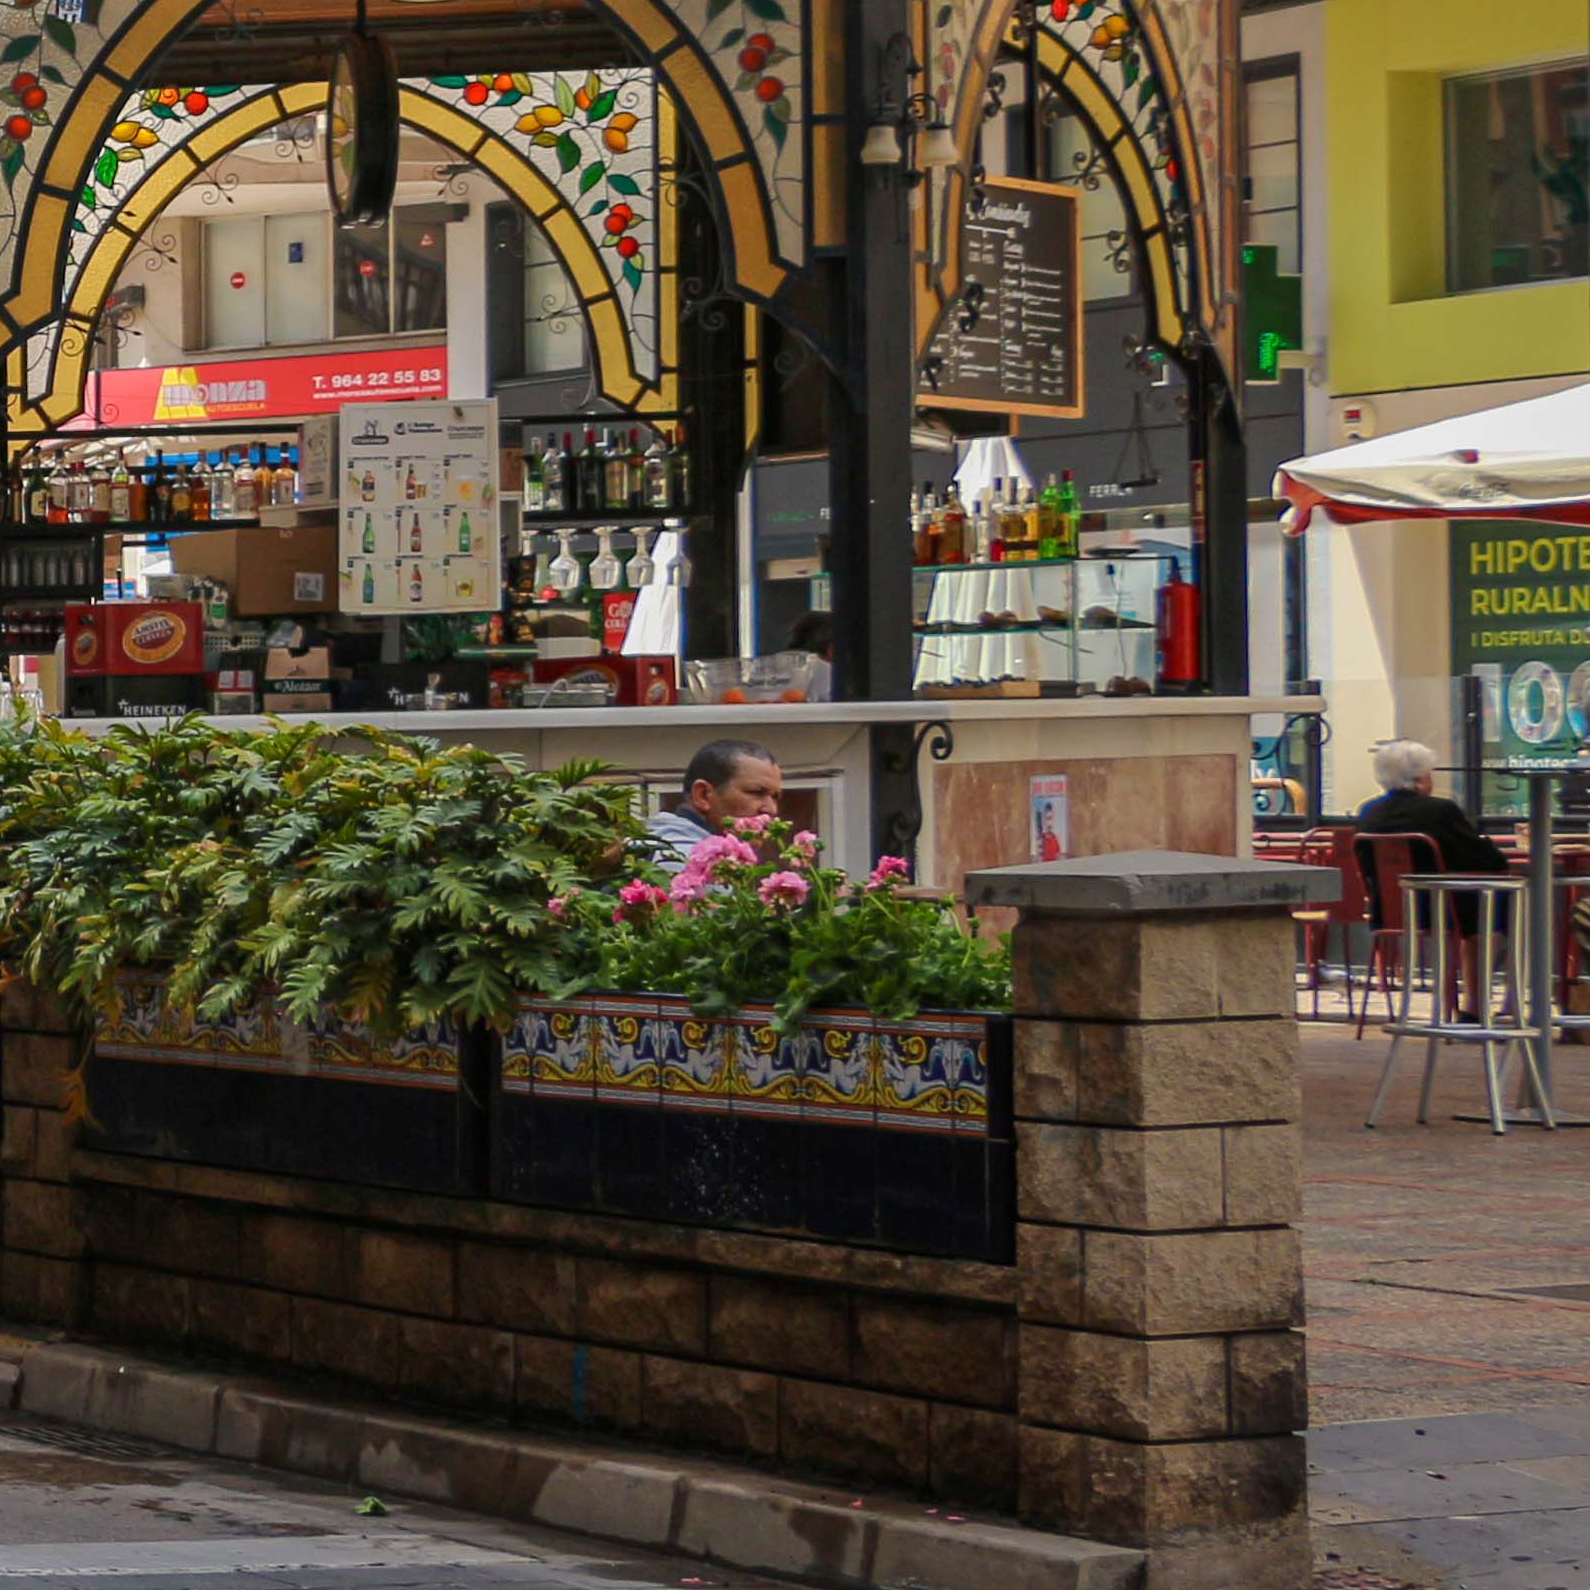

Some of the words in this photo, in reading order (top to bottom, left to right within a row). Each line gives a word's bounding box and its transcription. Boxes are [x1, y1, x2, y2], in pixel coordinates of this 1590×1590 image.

[312, 376, 327, 389] T.
[331, 373, 363, 388] 964
[368, 372, 389, 385] 22
[394, 370, 416, 384] 55
[419, 368, 441, 382] 83
[1481, 629, 1566, 647] DISFRUTA
[123, 704, 187, 717] HEINEKEN
